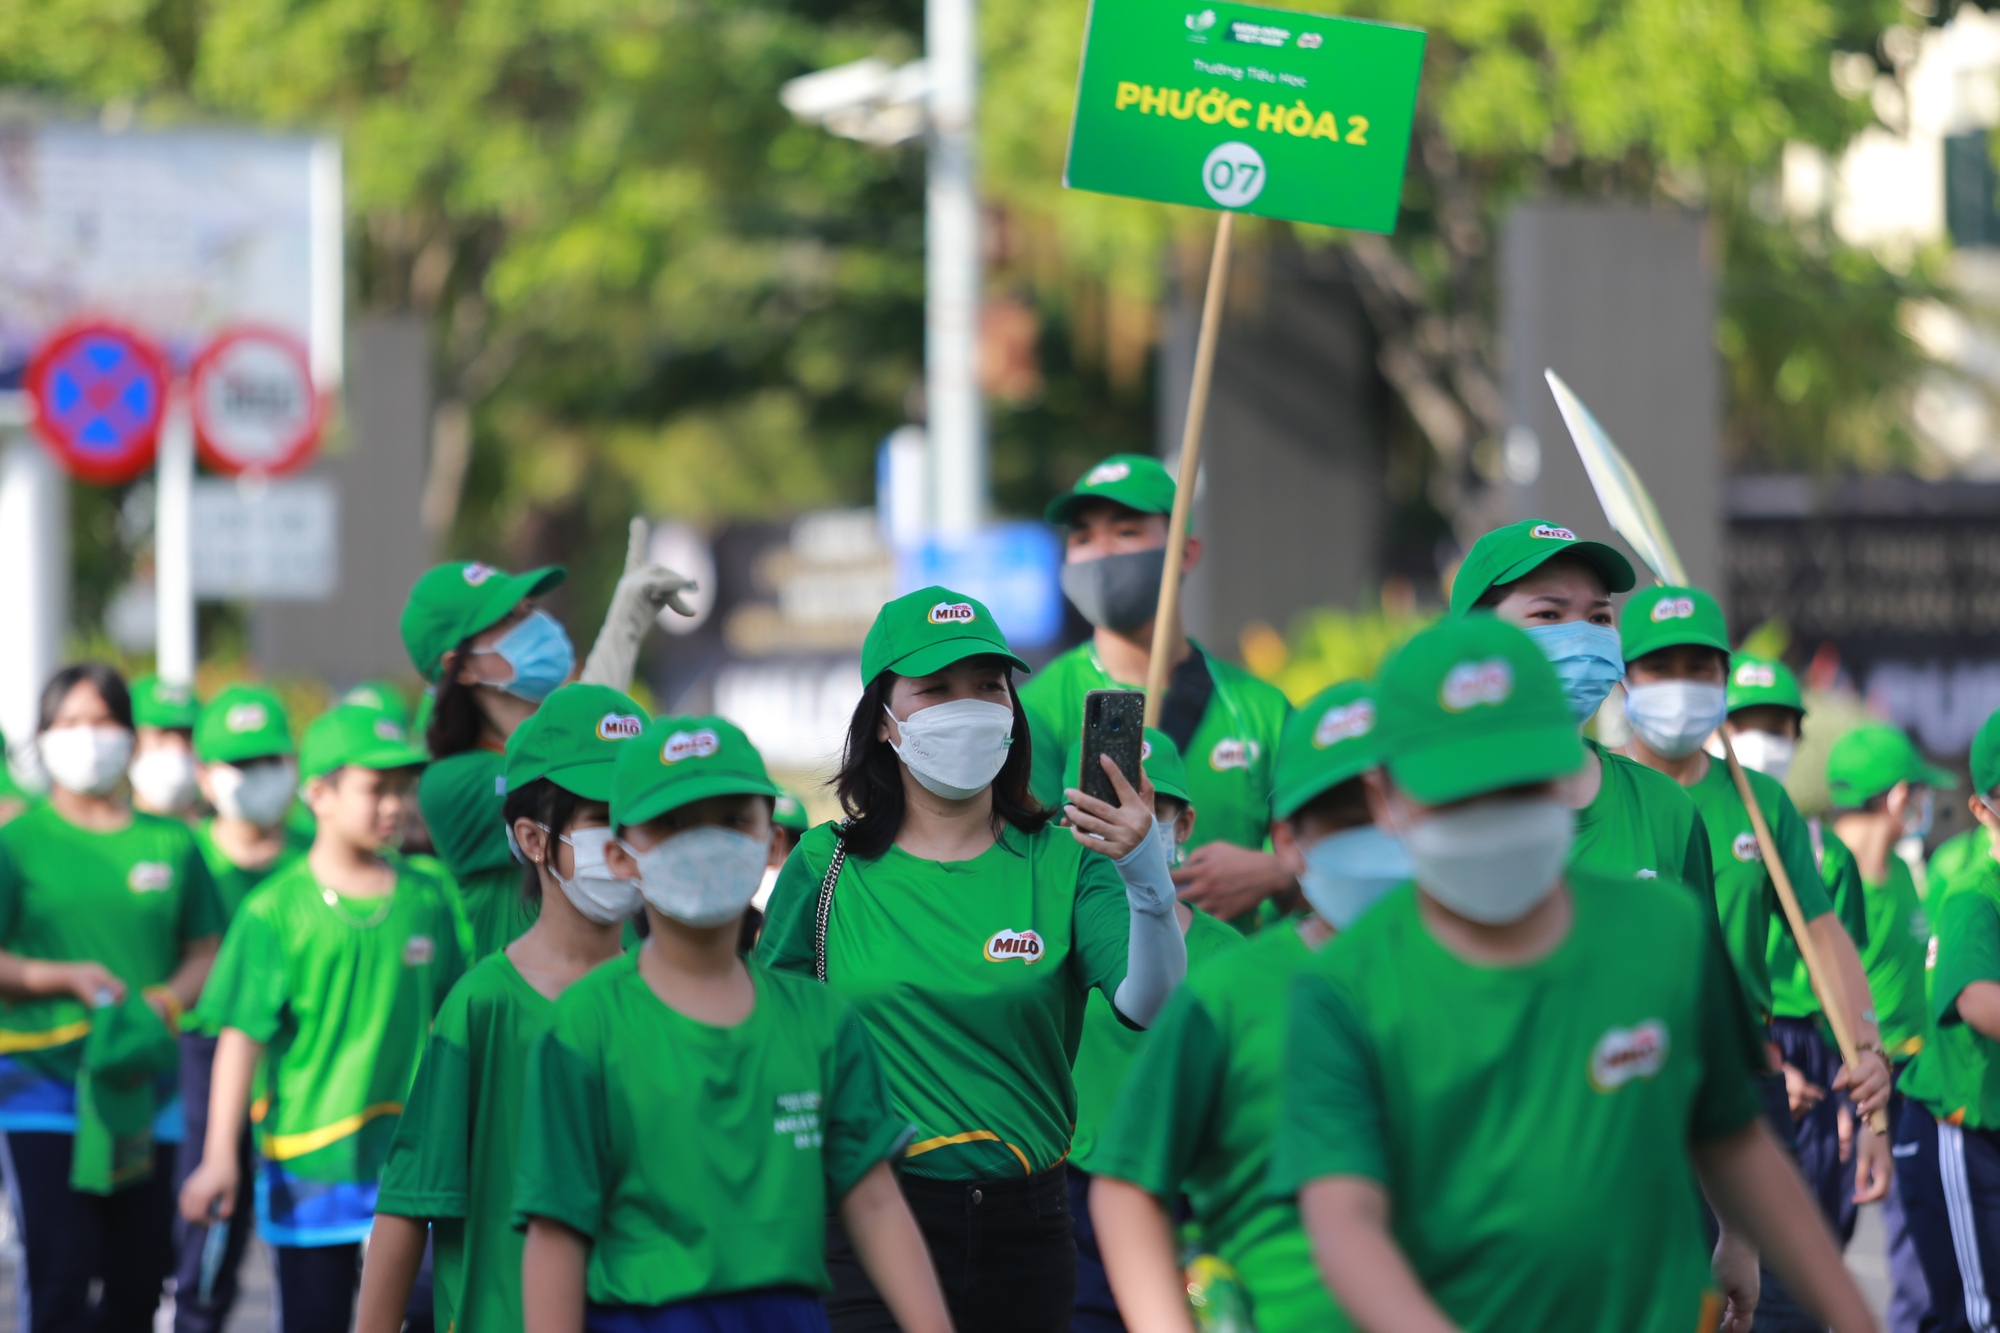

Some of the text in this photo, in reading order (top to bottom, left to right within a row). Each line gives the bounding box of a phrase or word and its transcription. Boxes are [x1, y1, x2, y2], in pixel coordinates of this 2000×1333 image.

[1115, 81, 1370, 146] PHƯỚC HÒA 2
[1209, 160, 1260, 194] 07
[1538, 529, 1573, 539] MILO
[935, 609, 971, 619] MILO
[605, 722, 639, 735] MILO
[993, 938, 1039, 955] MILO
